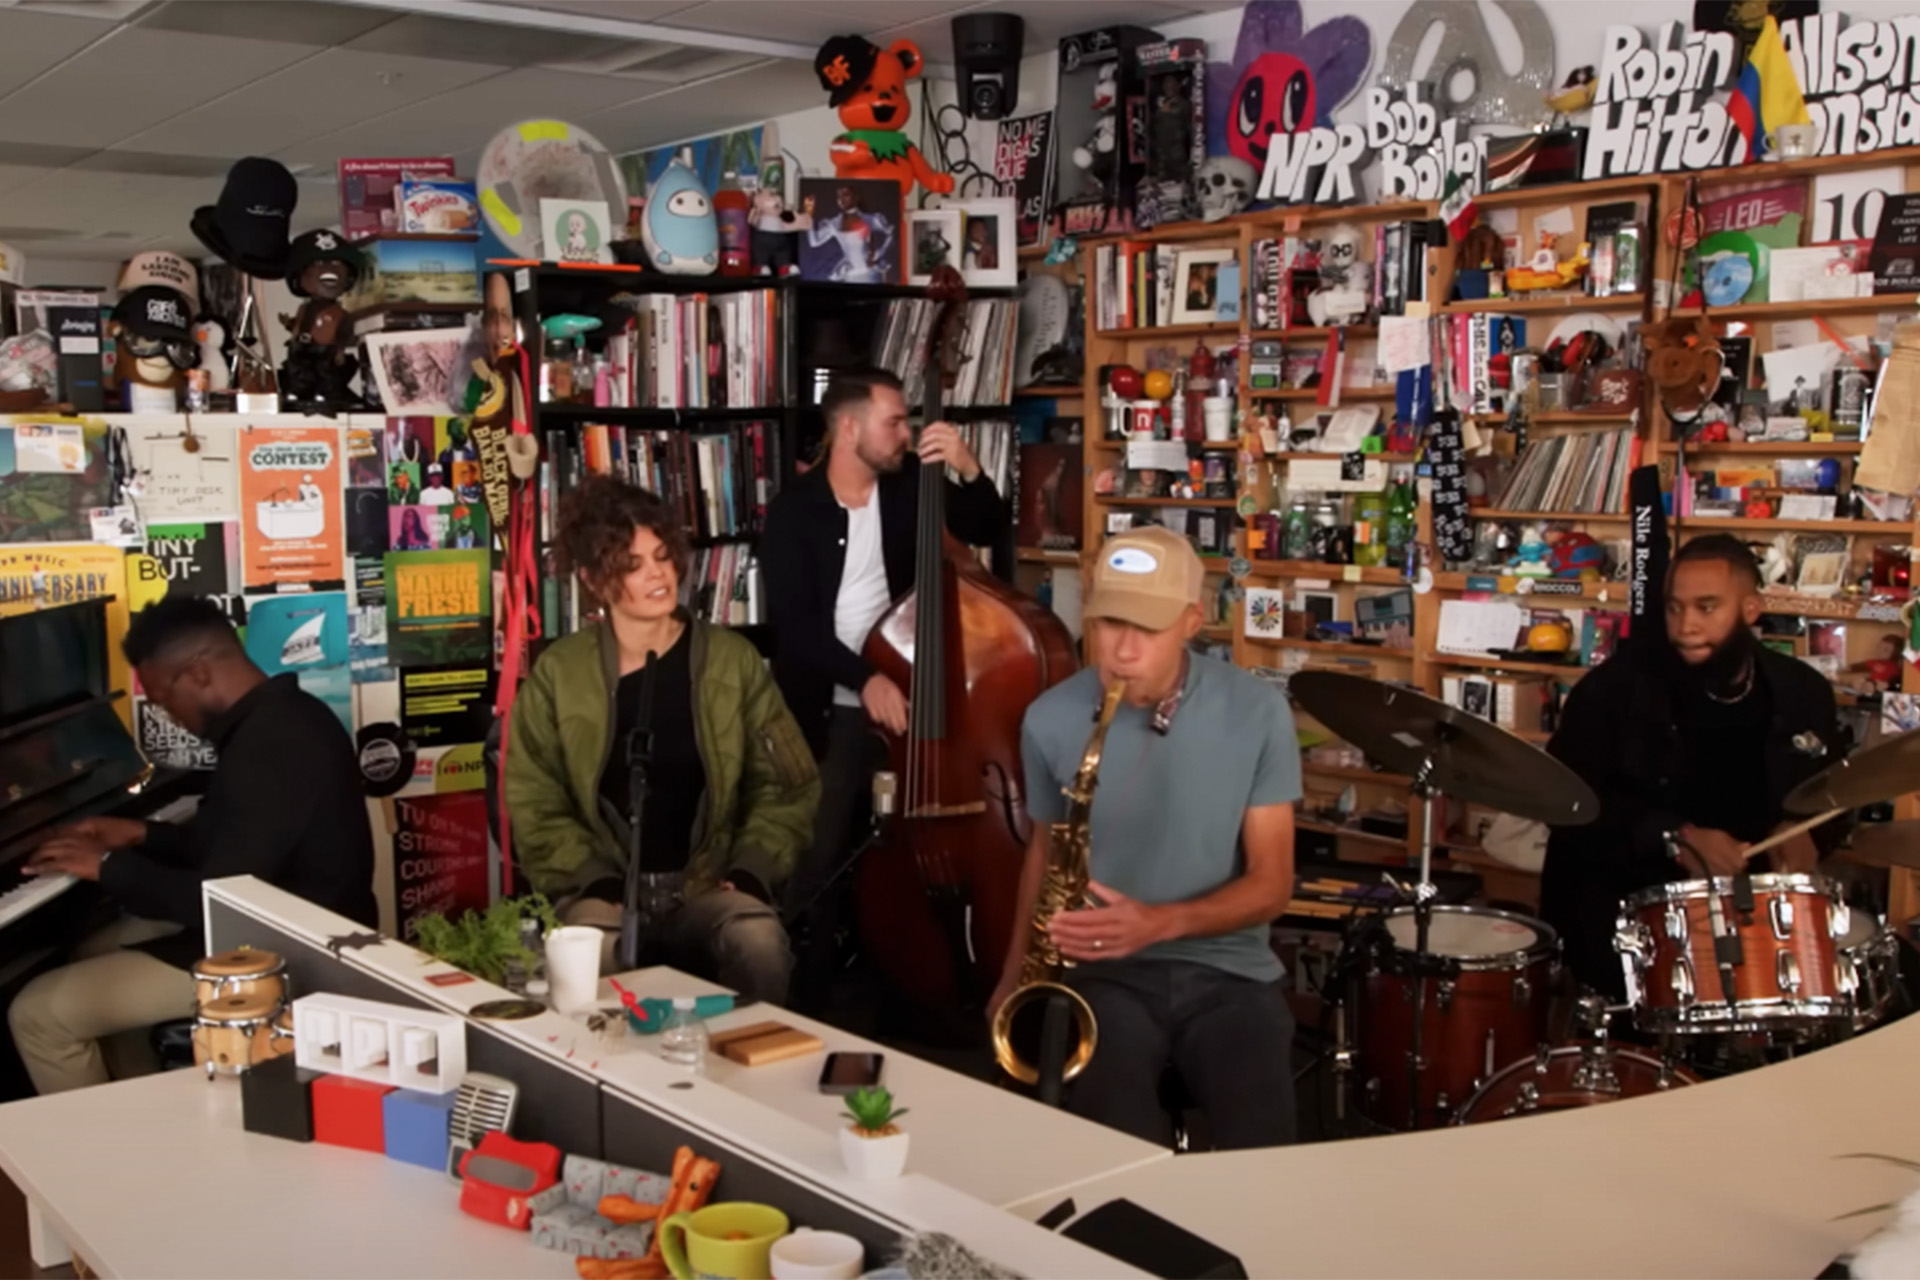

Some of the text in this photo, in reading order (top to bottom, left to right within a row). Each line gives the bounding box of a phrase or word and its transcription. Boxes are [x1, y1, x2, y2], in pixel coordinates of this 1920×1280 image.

[1594, 20, 1733, 104] Robin
[1367, 81, 1435, 148] Bob
[1582, 94, 1747, 180] Hilton
[1256, 124, 1366, 202] NPR
[1725, 199, 1762, 231] LEO
[252, 452, 328, 466] CONTEST
[492, 427, 509, 482] BLACK
[142, 538, 197, 556] TINY
[1633, 505, 1652, 615] Nile Rodgers
[139, 557, 201, 581] BUT-
[396, 565, 479, 593] MANNIE
[1533, 583, 1582, 593] BROCCOLI
[398, 593, 479, 617] FRESH
[145, 733, 200, 750] SEEDS
